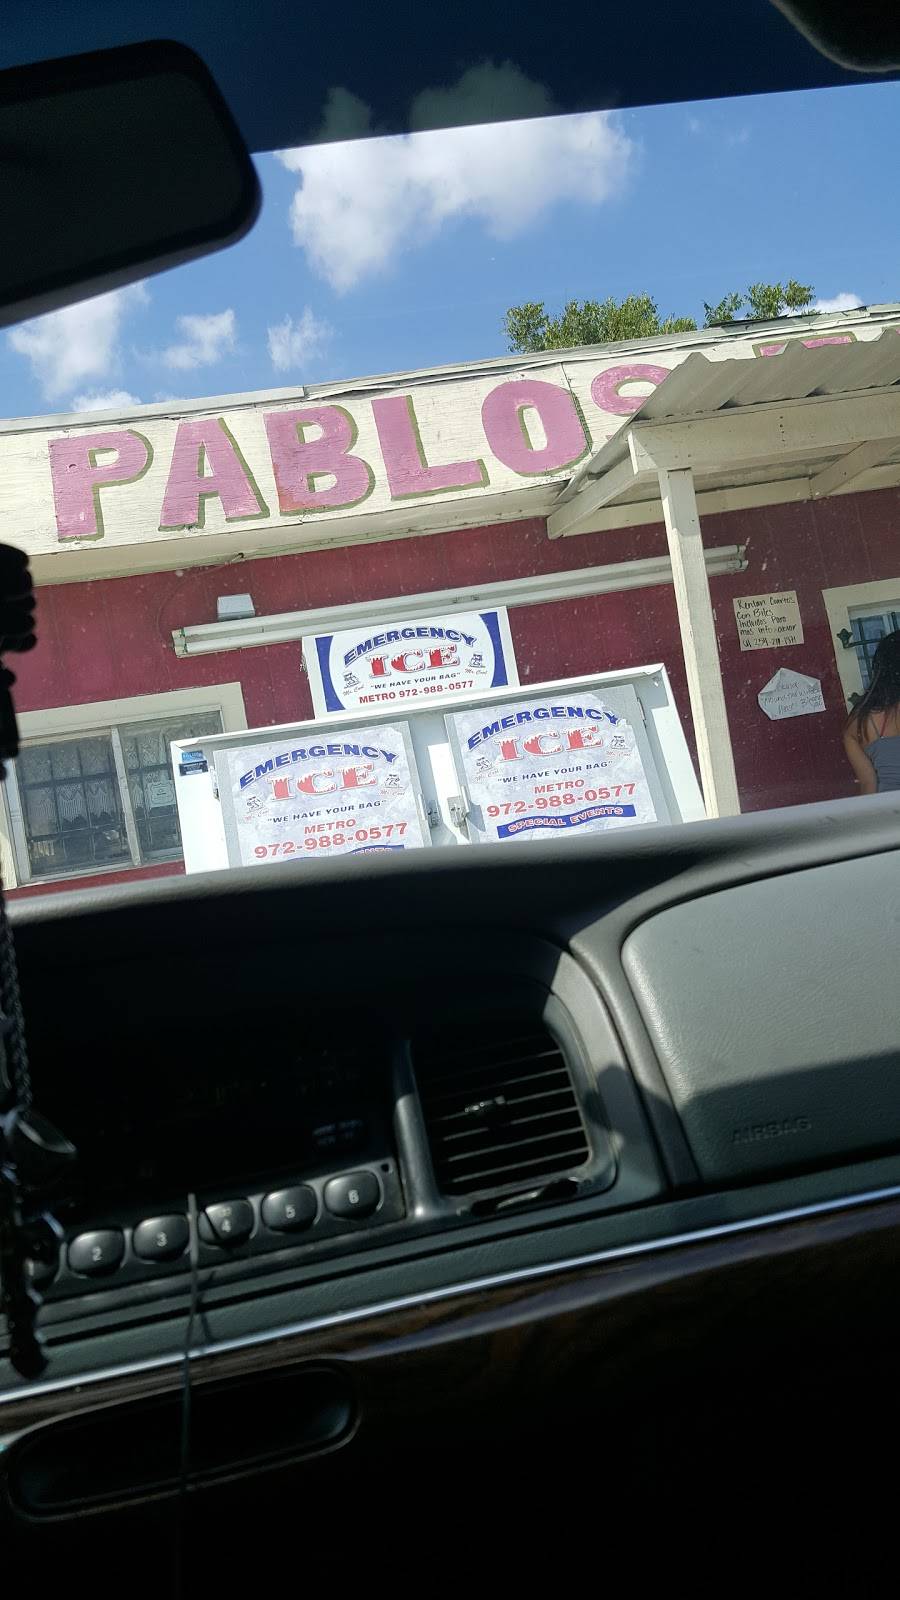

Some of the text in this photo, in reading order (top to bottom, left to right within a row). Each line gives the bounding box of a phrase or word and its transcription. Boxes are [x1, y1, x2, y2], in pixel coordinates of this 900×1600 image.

[343, 627, 478, 668] EMERGENCY
[364, 643, 461, 679] ICE
[359, 680, 474, 704] METRO 972-988-0577
[389, 679, 411, 688] HAVE
[414, 675, 437, 683] YOUR
[468, 706, 619, 751] EMERGENCY
[496, 725, 604, 763] ICE
[239, 744, 399, 790] EMERGENCY
[522, 770, 550, 780] HAVE
[554, 764, 582, 774] YOUR
[267, 762, 377, 801] ICE
[534, 779, 585, 795] METRO
[486, 783, 637, 817] 972-988-0577
[293, 811, 322, 821] HAVE
[326, 804, 355, 815] YOUR
[507, 806, 624, 834] SPECIAL EVENTS
[304, 818, 356, 834] METRO
[254, 823, 408, 859] 972-988-0577
[348, 1189, 360, 1204] 6
[221, 1219, 232, 1233] 4
[156, 1232, 168, 1248] 3
[92, 1246, 103, 1262] 2
